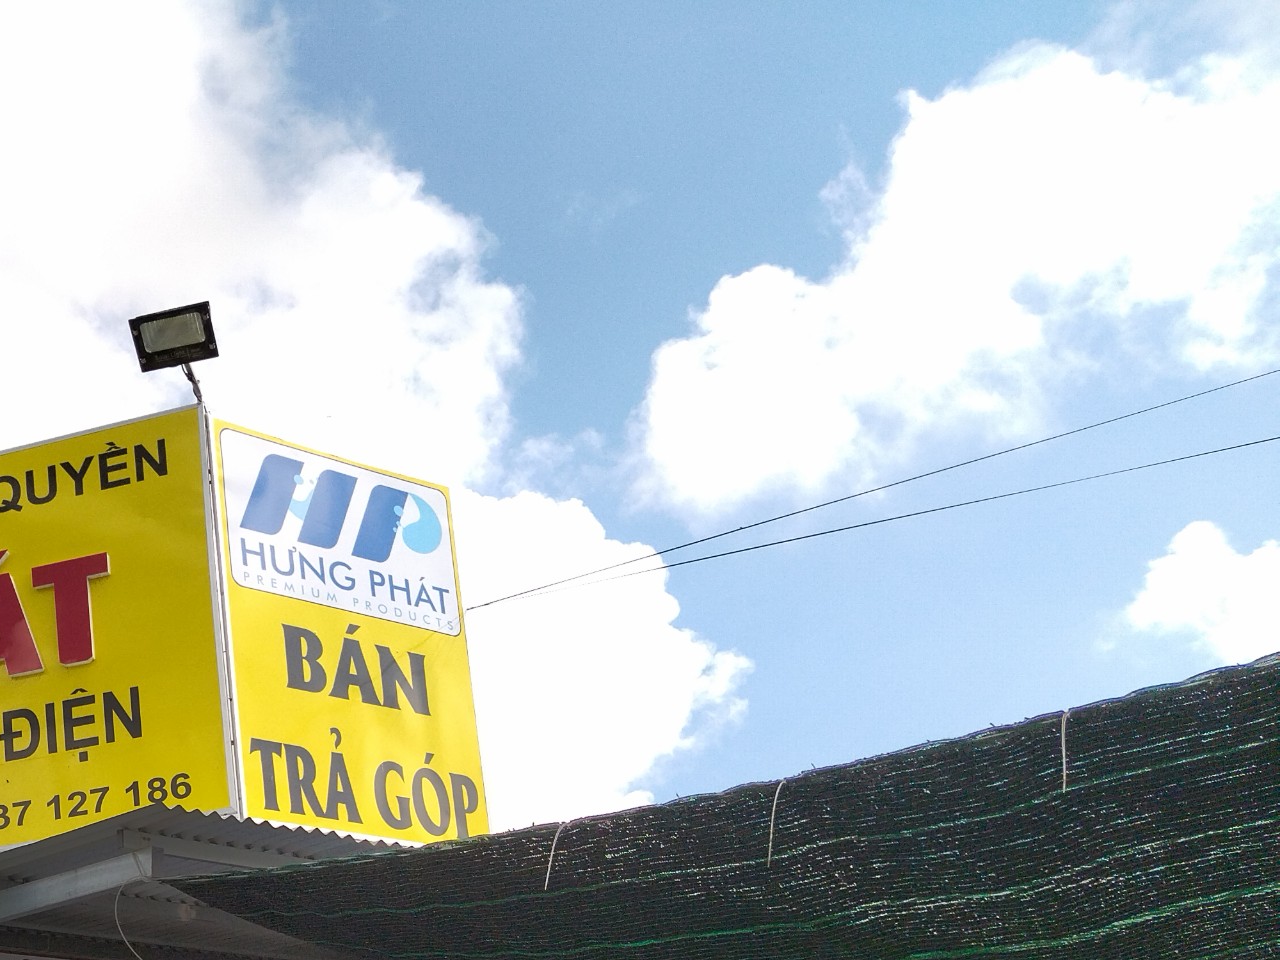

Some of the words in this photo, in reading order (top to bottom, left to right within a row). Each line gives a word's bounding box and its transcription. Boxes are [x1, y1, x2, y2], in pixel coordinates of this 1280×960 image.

[240, 537, 356, 591] HƯNG
[369, 575, 449, 615] PHÁT
[243, 571, 338, 603] PREMIUM
[353, 597, 455, 631] PRODUCTS
[281, 623, 431, 717] BÁN
[0, 686, 143, 762] ĐIỆN
[46, 786, 111, 821] 127
[125, 773, 192, 807] 186
[250, 727, 363, 825] TRẢ
[374, 753, 478, 838] GÓP
